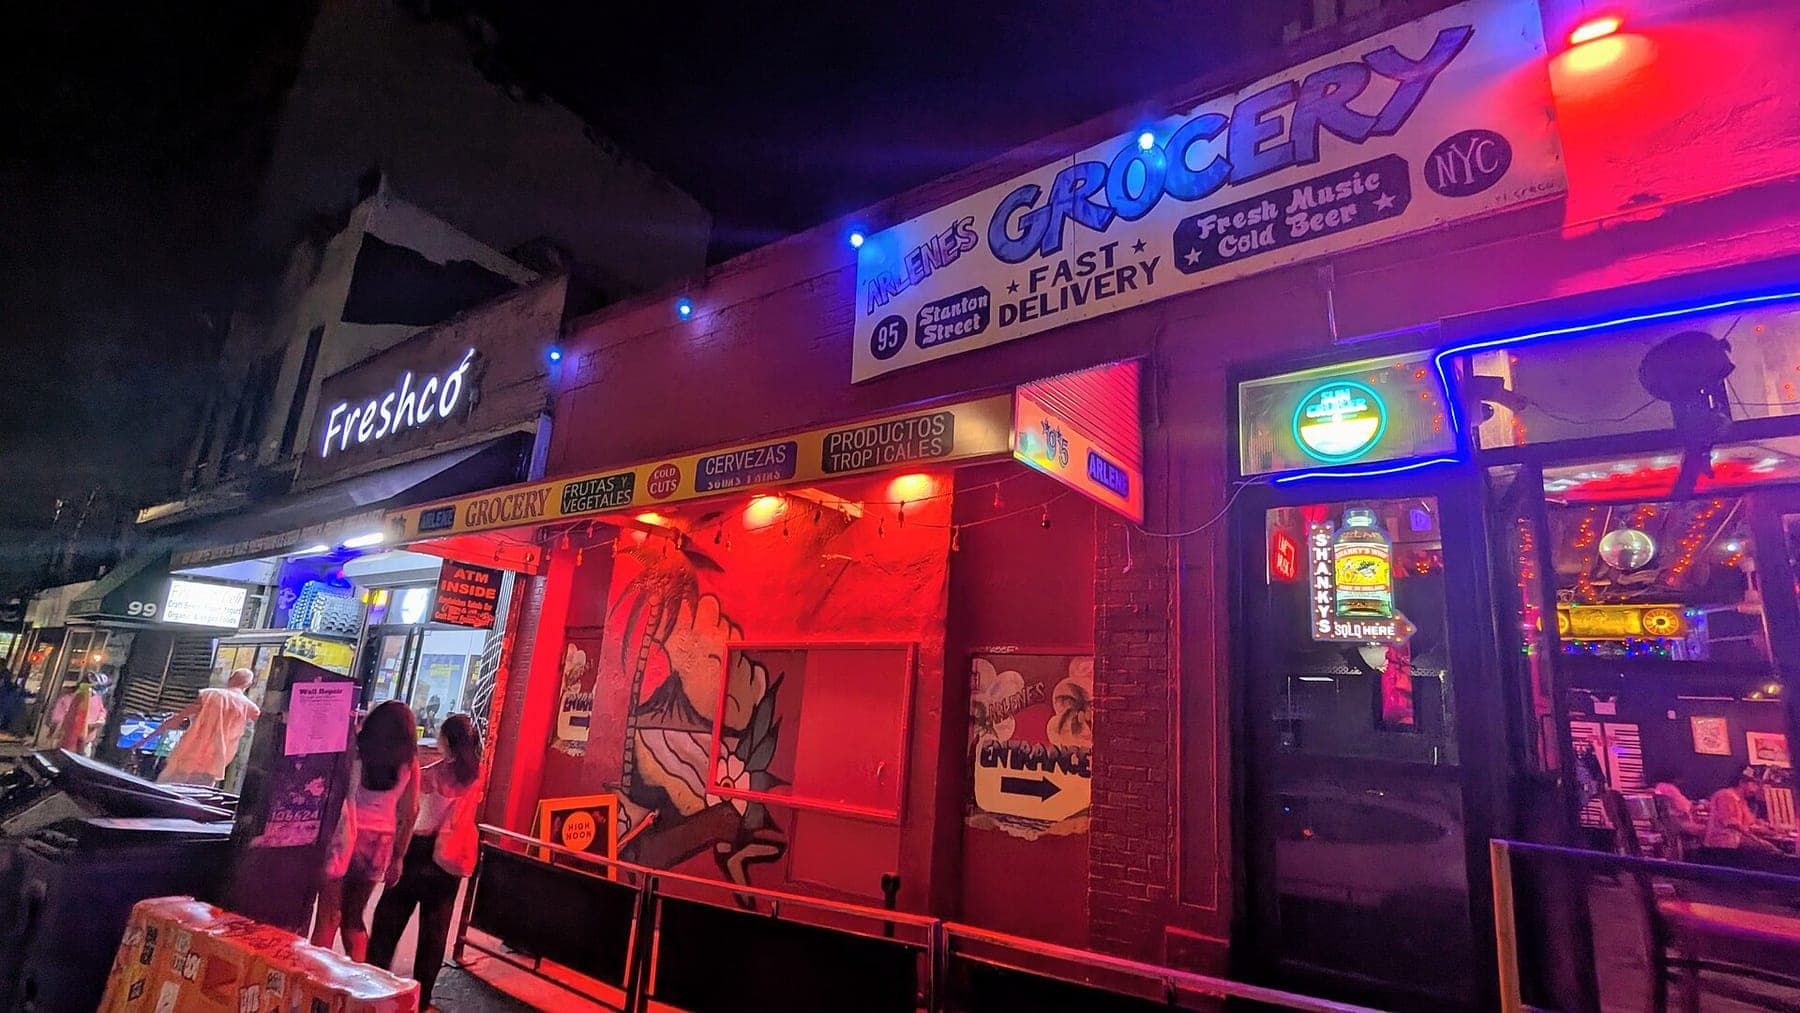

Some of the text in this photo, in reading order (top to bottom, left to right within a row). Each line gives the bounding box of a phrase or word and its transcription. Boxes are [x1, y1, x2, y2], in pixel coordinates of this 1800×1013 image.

[987, 25, 1475, 264] GROCERY
[1436, 139, 1499, 189] NYC
[1197, 172, 1380, 241] Fresh Music
[1217, 204, 1358, 257] Cold Beer
[1030, 241, 1118, 293] FAST
[999, 256, 1161, 328] DELIVERY
[919, 293, 989, 325] Stanton
[877, 321, 899, 352] 95
[922, 312, 981, 344] Street
[829, 414, 945, 453] PRODUCTOS
[705, 444, 786, 475] CERVEZAS
[830, 438, 943, 472] TROPICALES
[564, 476, 628, 498] FRUTAS Y
[650, 480, 677, 495] CUTS
[653, 467, 676, 480] COLD
[465, 488, 552, 528] GROCERY
[562, 489, 632, 513] VEGETALES
[441, 580, 497, 600] INSIDE
[454, 568, 489, 584] ATM
[127, 601, 157, 617] 99
[1334, 624, 1396, 638] SOLD HERE
[980, 739, 1092, 779] ENTRANCE
[568, 822, 590, 831] HIGH
